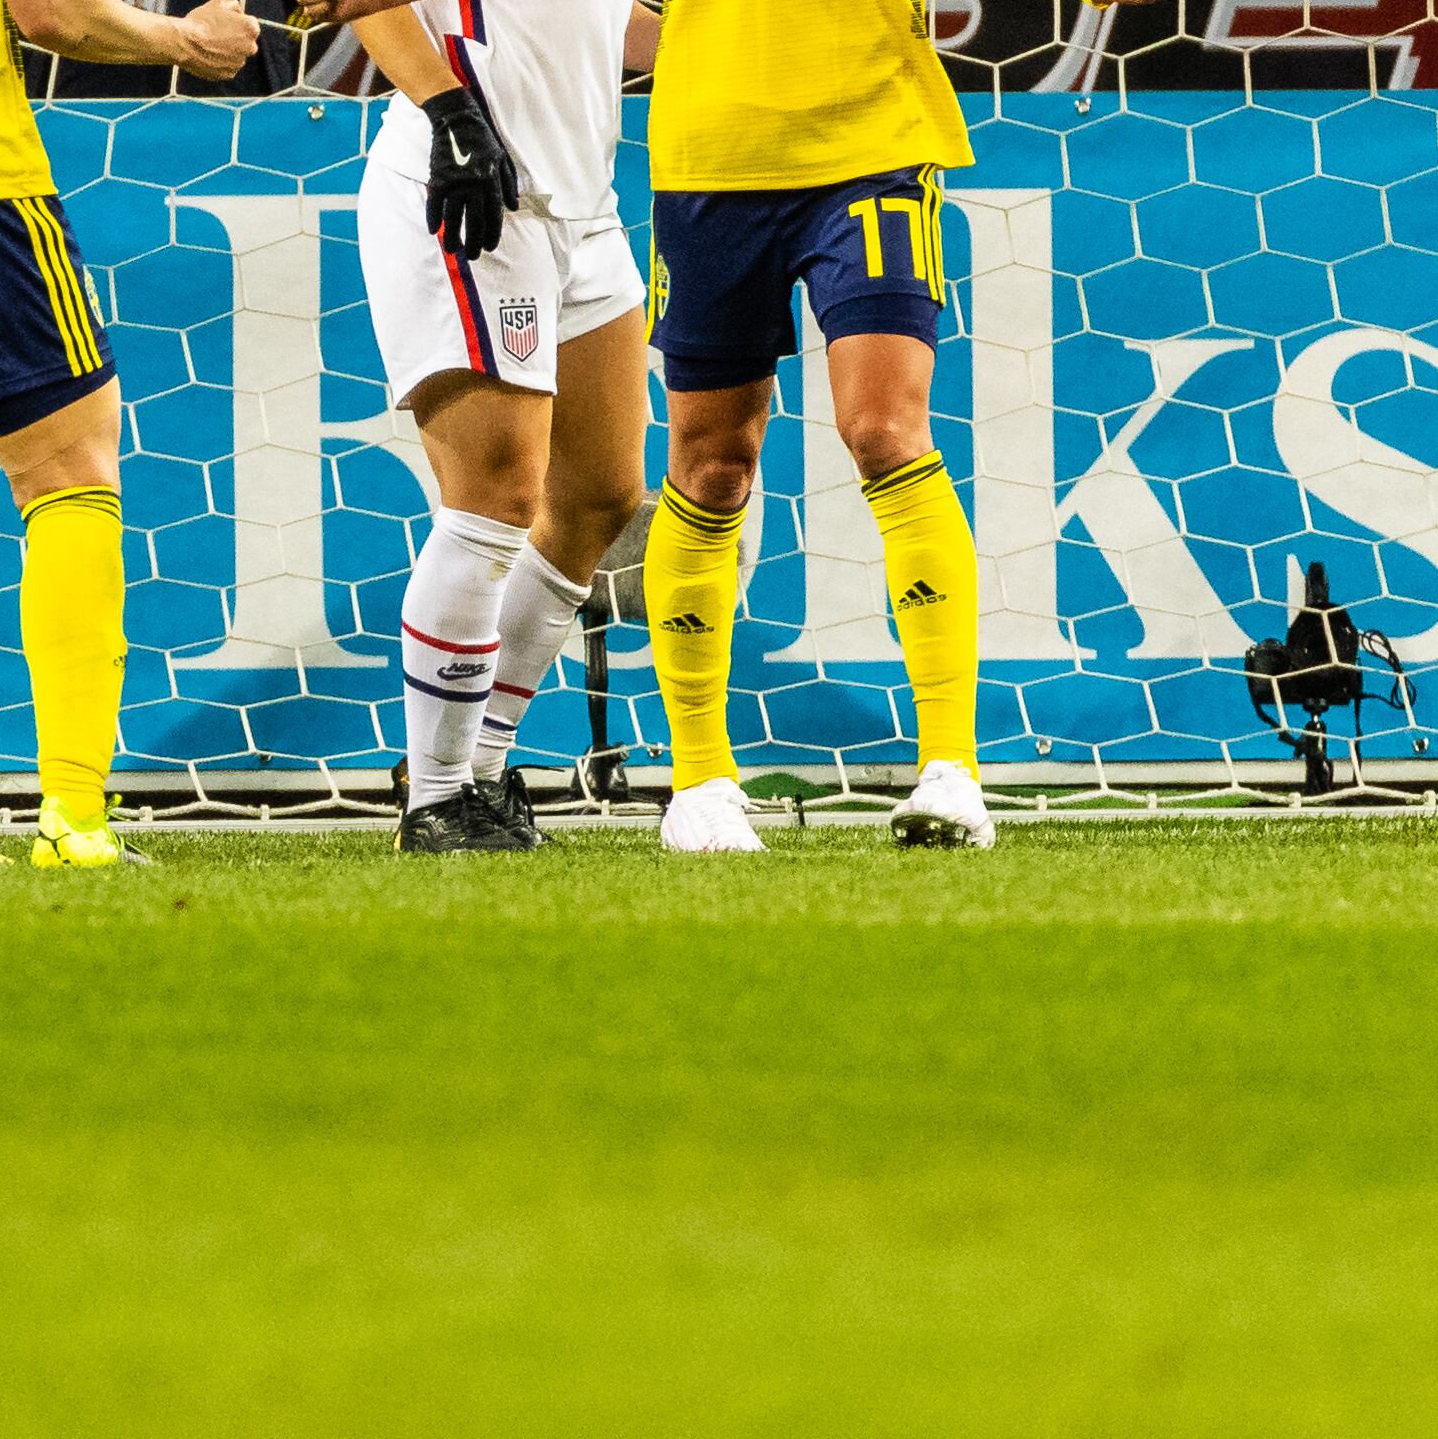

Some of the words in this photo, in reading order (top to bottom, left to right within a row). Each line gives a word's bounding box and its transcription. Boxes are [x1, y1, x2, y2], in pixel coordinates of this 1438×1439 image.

[847, 196, 927, 281] 17
[504, 310, 534, 330] USA
[896, 592, 948, 612] adidas
